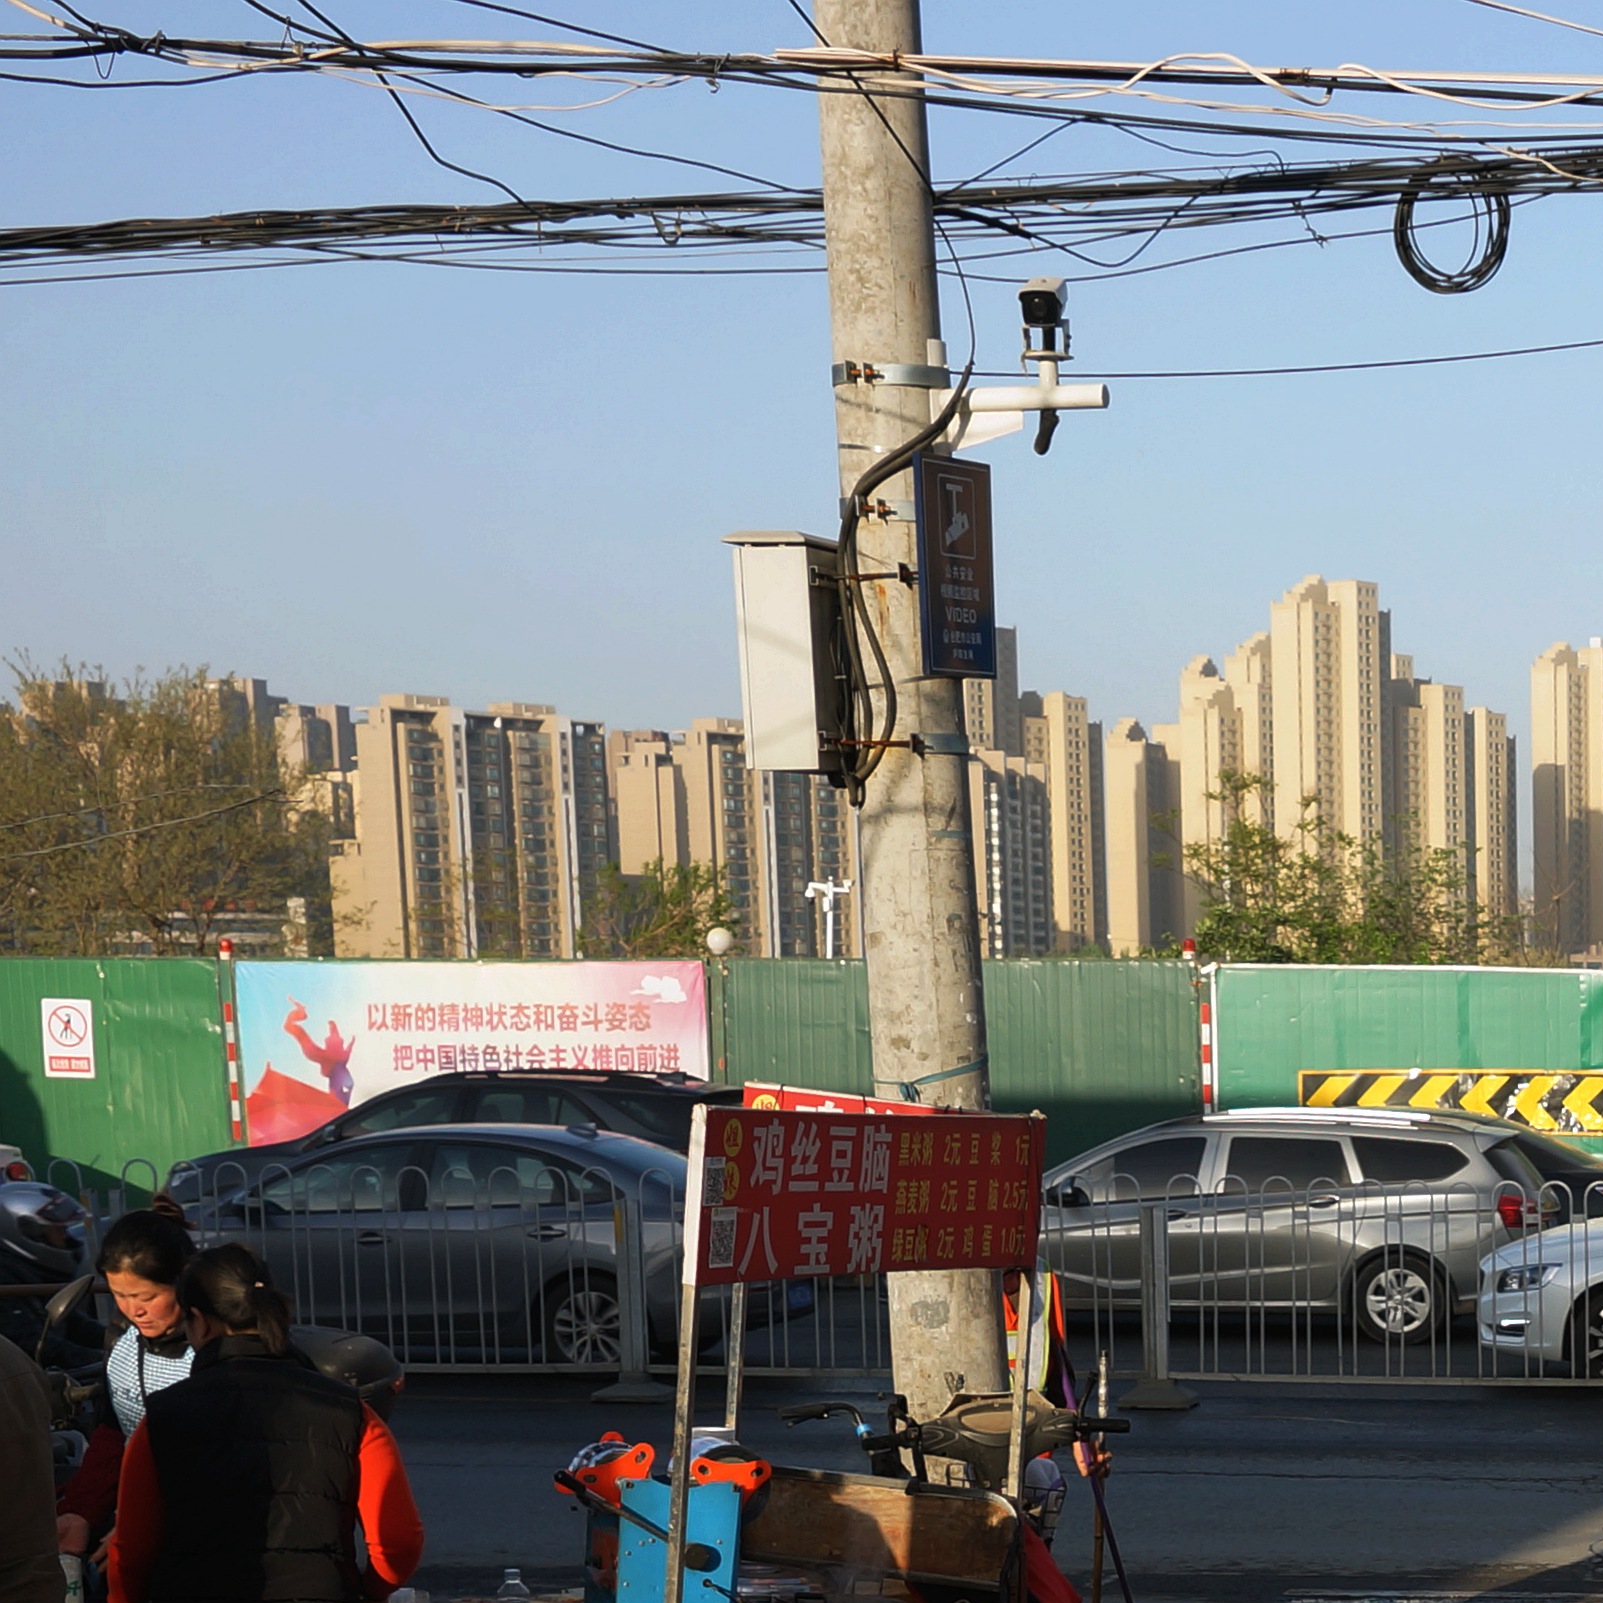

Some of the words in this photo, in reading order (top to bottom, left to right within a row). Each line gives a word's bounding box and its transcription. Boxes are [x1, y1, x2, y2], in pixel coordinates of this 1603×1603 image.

[945, 606, 977, 624] VIDEO
[366, 1002, 651, 1033] 以新的精神状态和奋斗姿态
[392, 1043, 681, 1072] 把中国特色社会主义推向前进
[749, 1117, 893, 1197] 鸡丝豆脑
[897, 1131, 934, 1167] 黑米粥
[943, 1133, 961, 1166] 2元
[1015, 1134, 1030, 1166] 1元
[895, 1178, 931, 1215] 燕麦粥
[940, 1180, 958, 1213] 2元
[737, 1202, 885, 1276] 八宝粥
[891, 1225, 929, 1263] 绿豆粥
[936, 1227, 954, 1259] 2元
